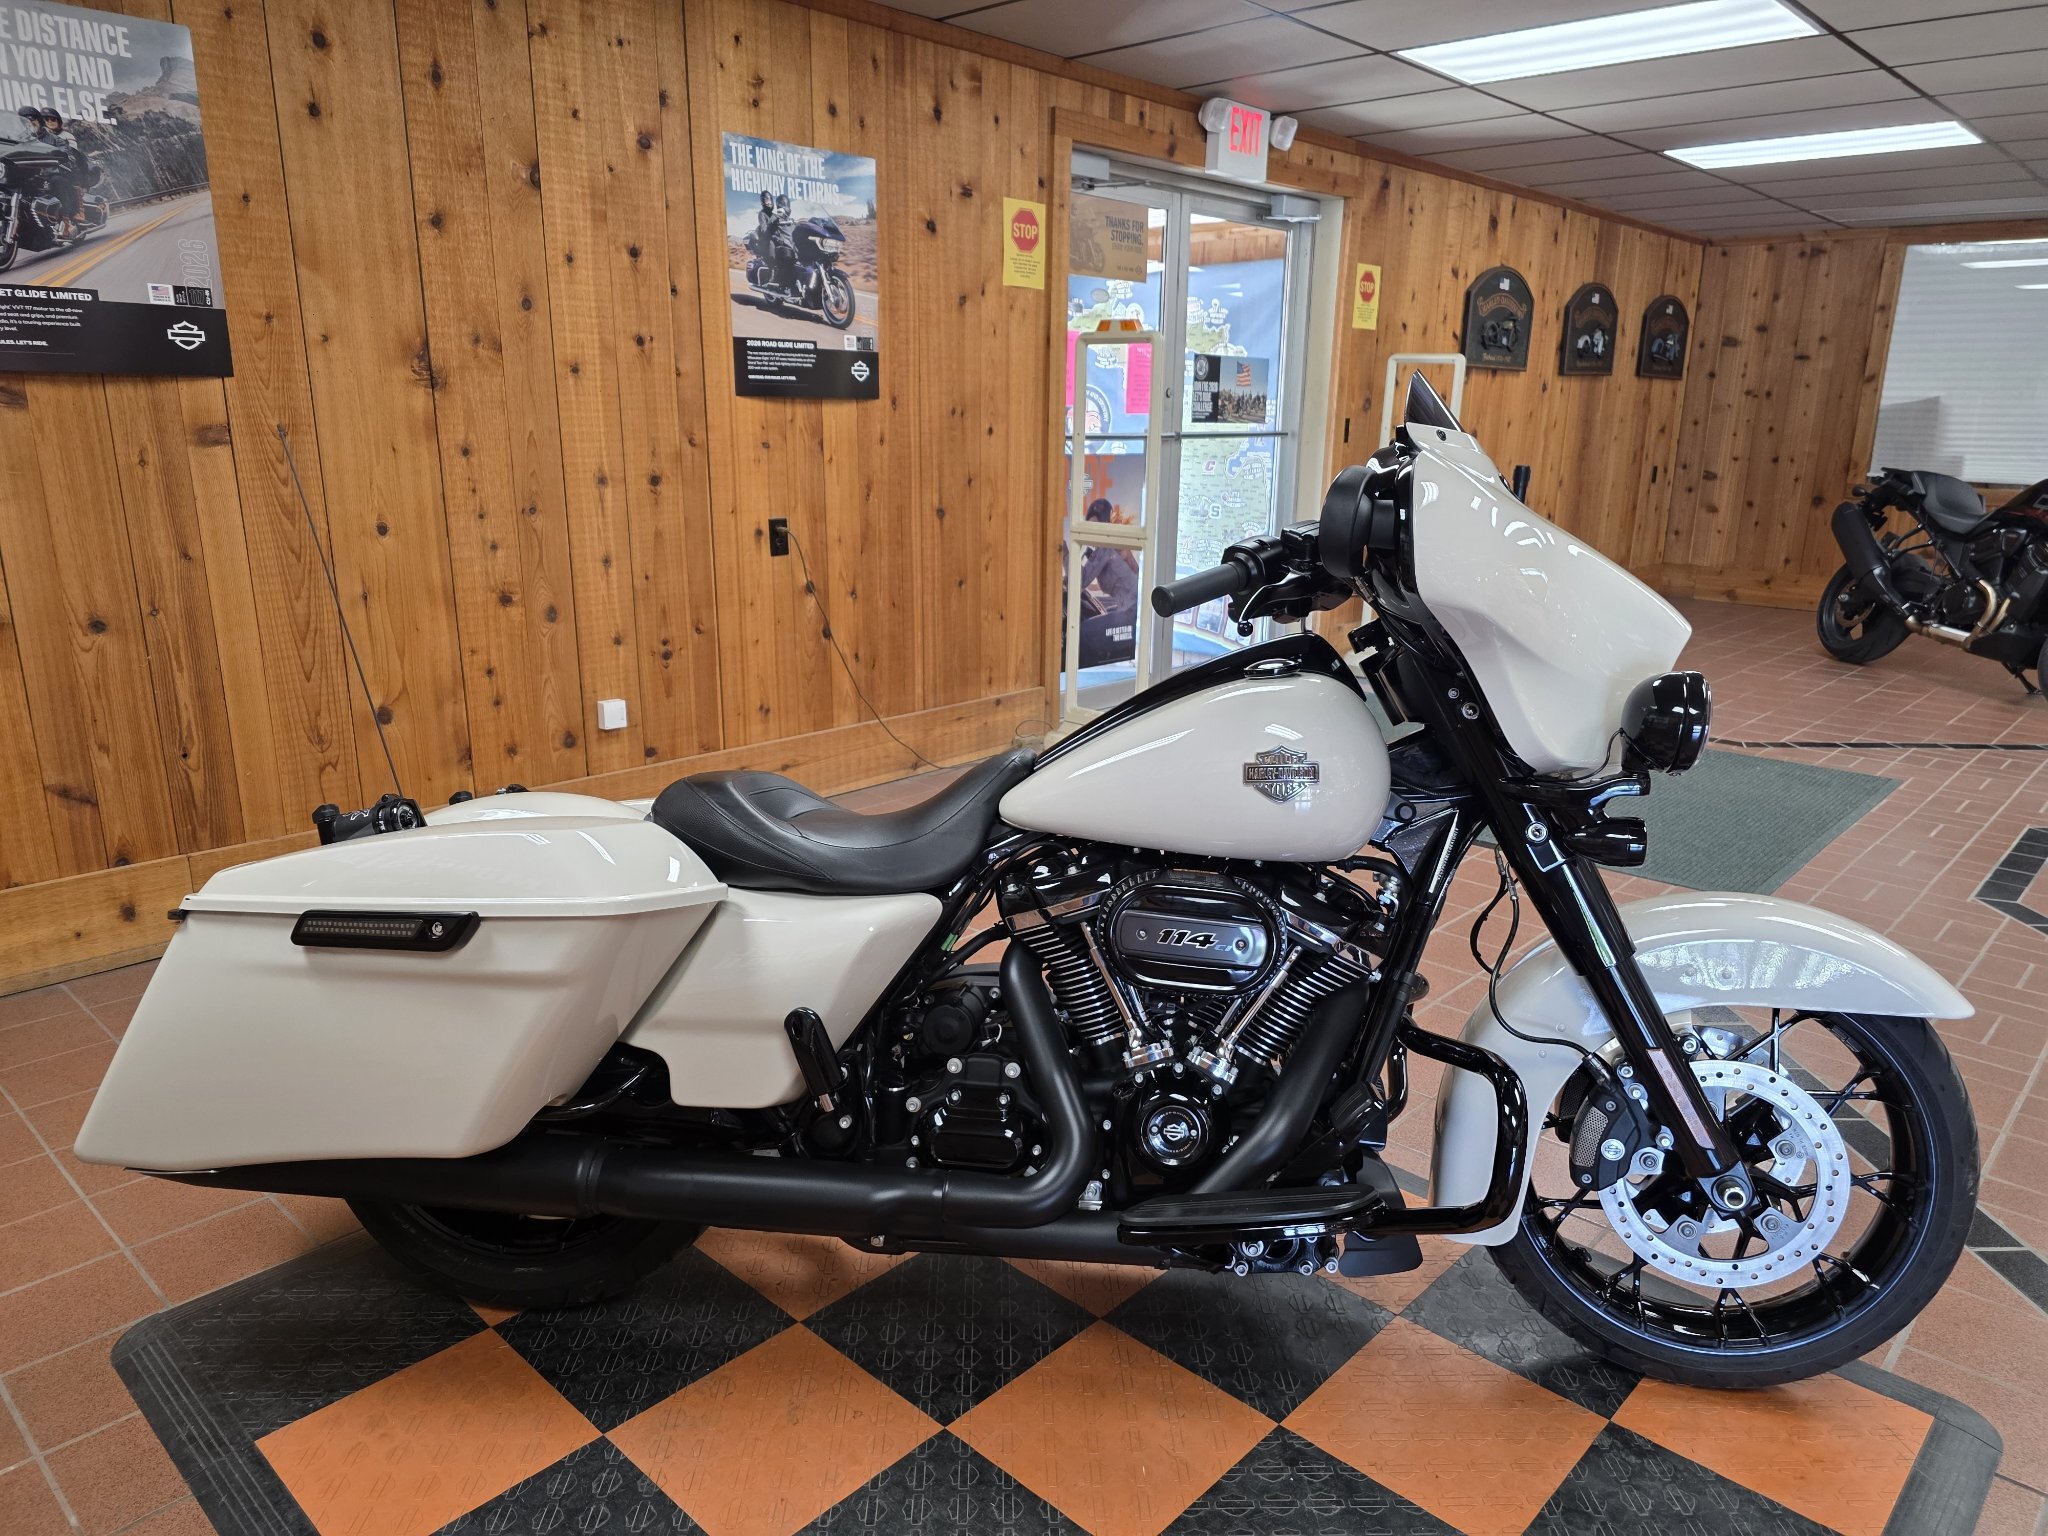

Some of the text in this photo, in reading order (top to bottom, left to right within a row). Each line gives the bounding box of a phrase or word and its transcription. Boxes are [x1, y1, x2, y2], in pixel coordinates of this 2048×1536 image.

[15, 8, 132, 58] DISTANCE
[9, 43, 60, 82] YOU
[65, 52, 115, 90] AND
[52, 87, 118, 126] ELSE.
[1229, 106, 1263, 157] EXIT
[729, 141, 826, 179] THE KING OF THE
[730, 168, 785, 197] HIGHWAY
[1013, 222, 1038, 240] STOP
[1105, 215, 1144, 233] THANKS FOR
[14, 289, 48, 299] GLIDE
[49, 291, 93, 301] LIMITED
[1360, 281, 1375, 293] STOP
[1248, 767, 1315, 780] HARLEY-DAVIDSON
[1157, 928, 1219, 949] 114
